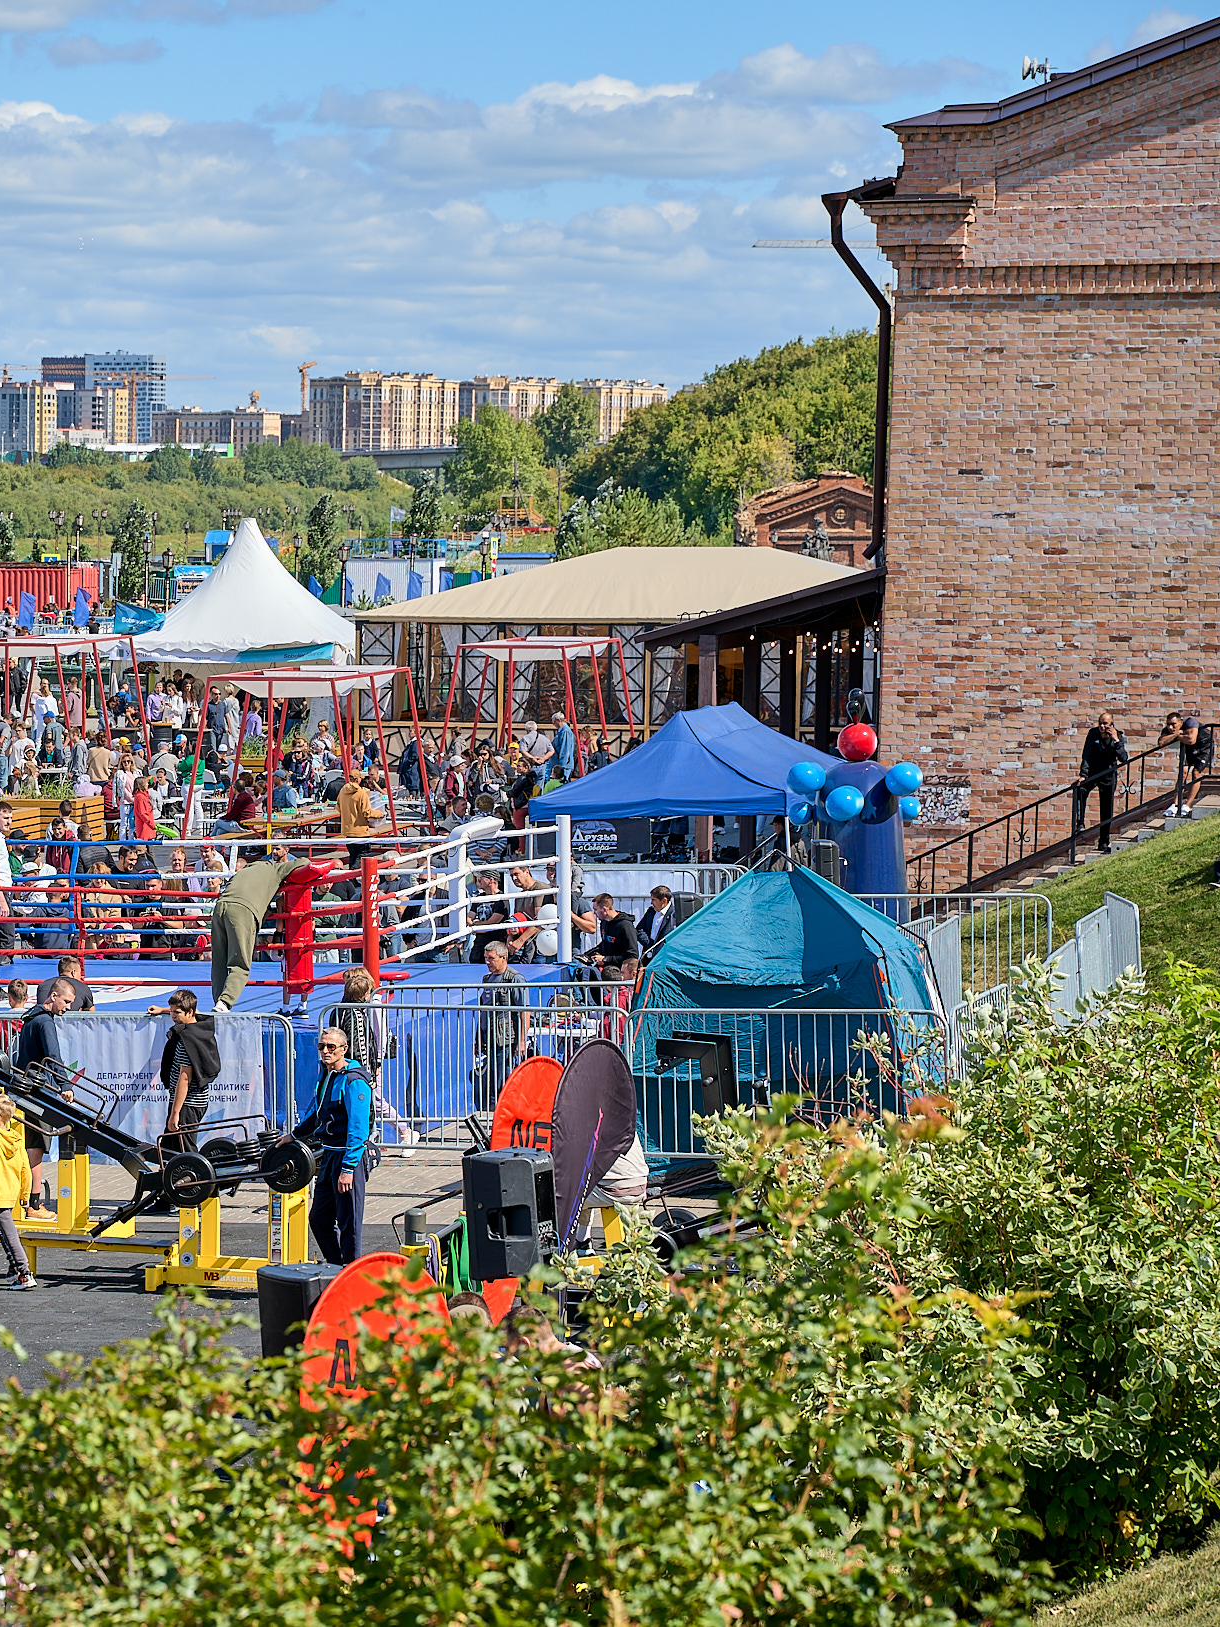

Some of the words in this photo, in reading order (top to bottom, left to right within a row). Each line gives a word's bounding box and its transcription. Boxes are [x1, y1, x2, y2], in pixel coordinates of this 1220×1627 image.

[369, 874, 379, 927] ТЮМЕНЬ
[96, 1072, 154, 1080] ДЕПАРТАМЕНТ
[109, 1083, 140, 1091] СПОРТУ
[204, 1271, 220, 1281] MB
